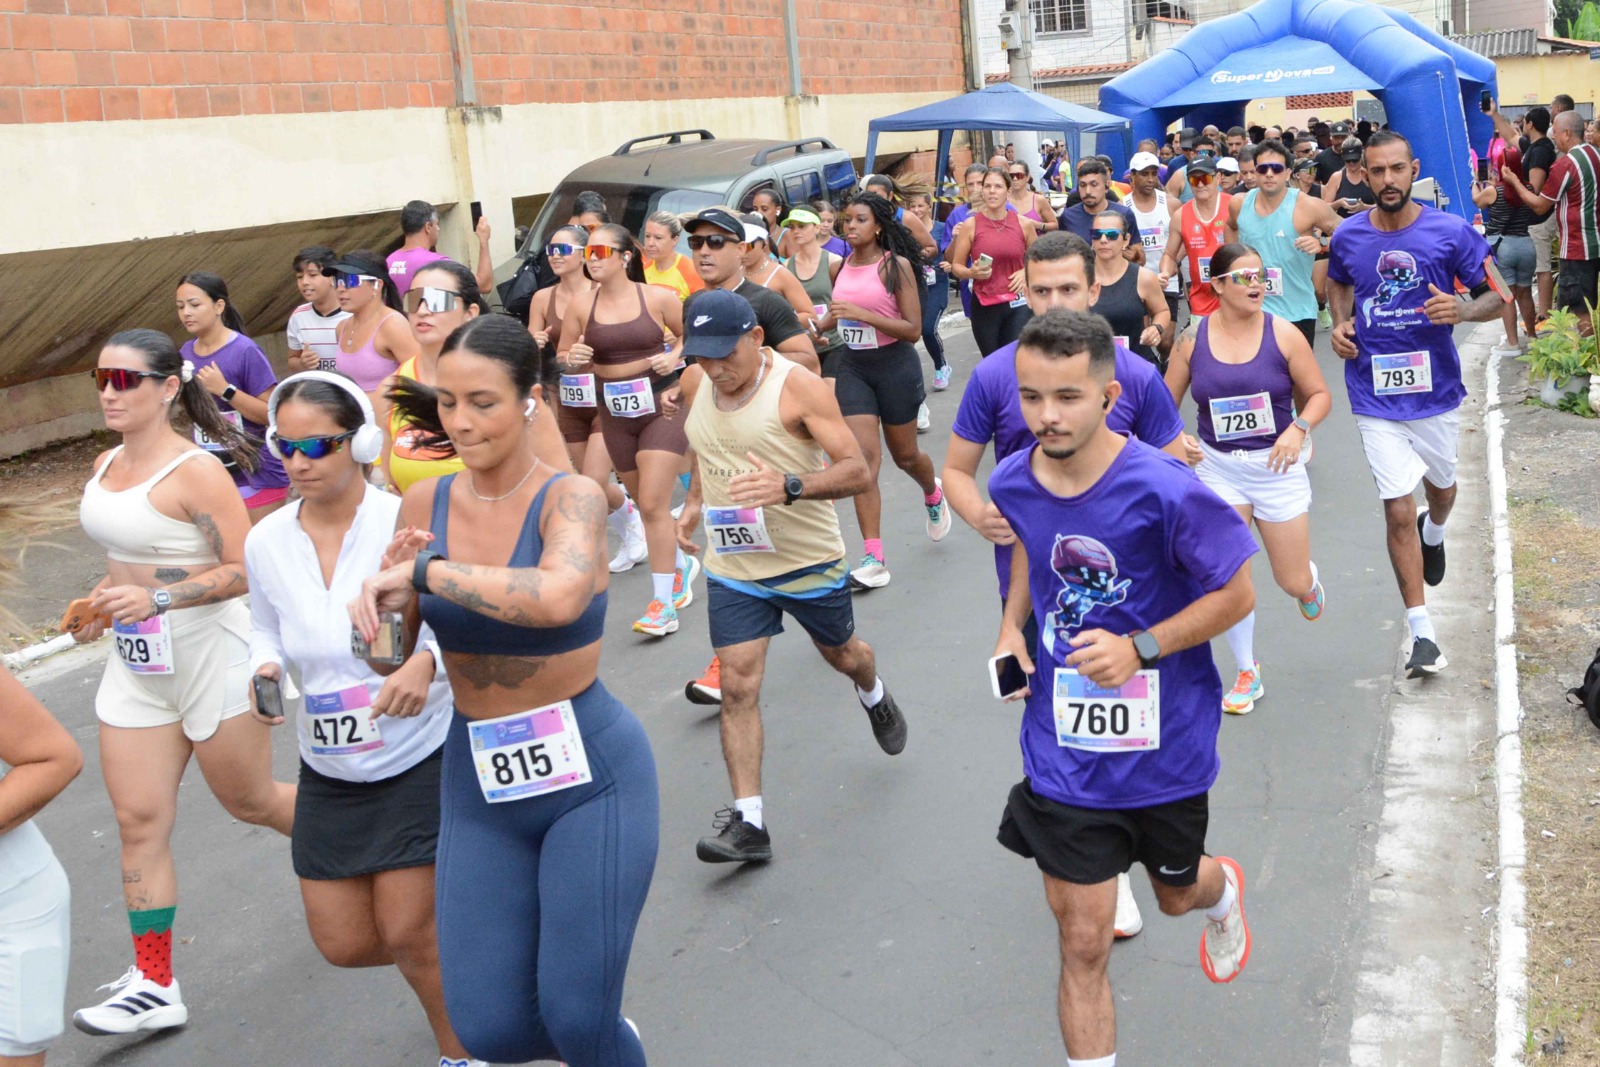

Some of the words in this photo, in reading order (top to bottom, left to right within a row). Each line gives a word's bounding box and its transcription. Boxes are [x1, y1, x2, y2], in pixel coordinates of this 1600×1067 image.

[843, 329, 863, 343] 677
[1381, 369, 1415, 388] 793
[563, 388, 584, 401] 799
[612, 395, 640, 412] 673
[1221, 412, 1257, 433] 728
[714, 527, 754, 546] 756
[117, 636, 150, 663] 629
[1068, 702, 1129, 736] 760
[314, 715, 363, 746] 472
[491, 743, 553, 786] 815
